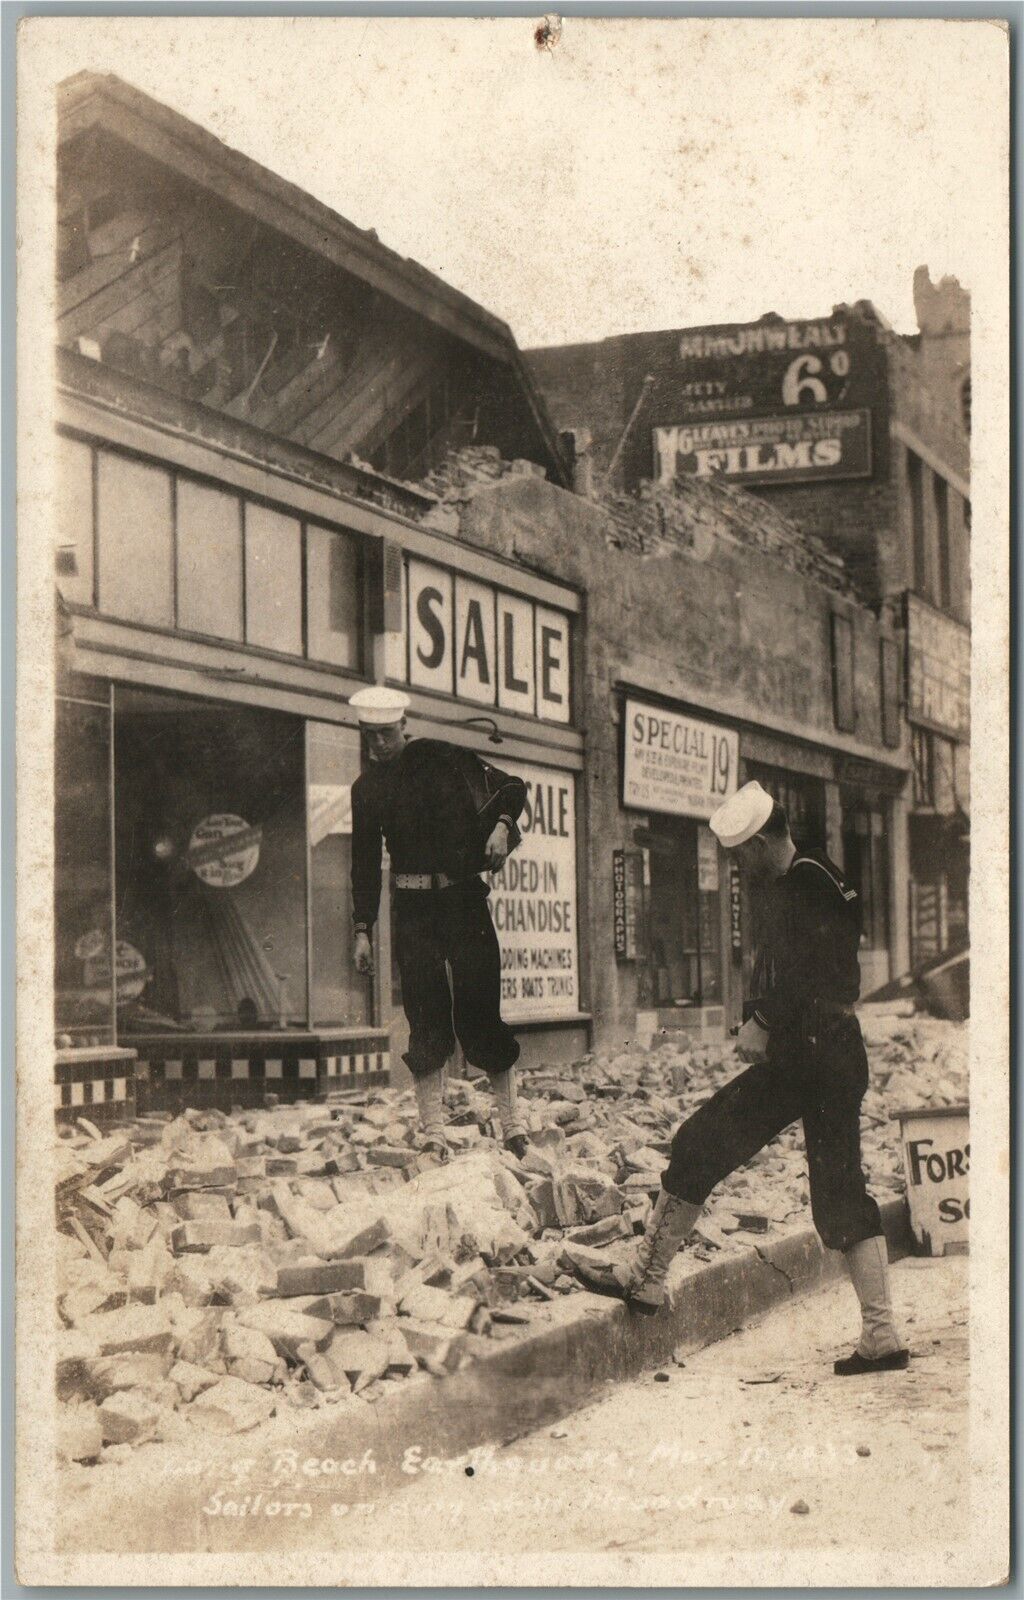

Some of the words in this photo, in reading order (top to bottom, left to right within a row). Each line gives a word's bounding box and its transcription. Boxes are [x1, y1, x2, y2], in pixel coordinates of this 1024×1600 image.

[696, 438, 841, 477] FILMS
[416, 586, 563, 704] SALE
[632, 713, 708, 759] SPECIAL
[522, 781, 569, 838] SALE
[487, 897, 571, 933] CHANDISE
